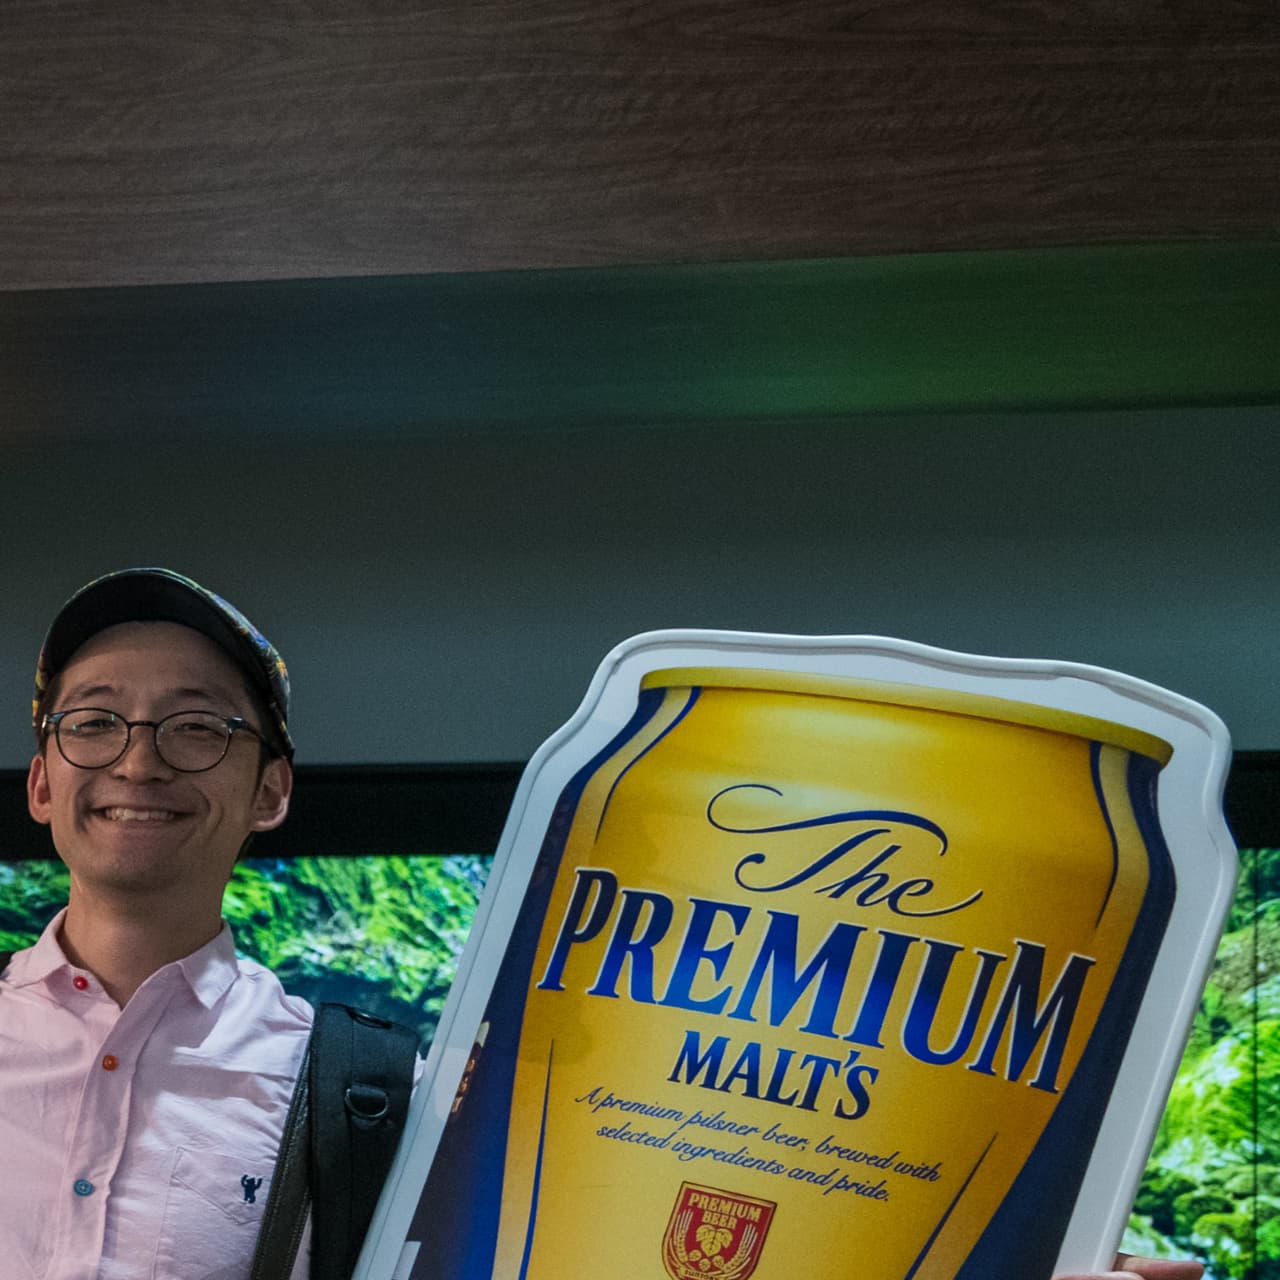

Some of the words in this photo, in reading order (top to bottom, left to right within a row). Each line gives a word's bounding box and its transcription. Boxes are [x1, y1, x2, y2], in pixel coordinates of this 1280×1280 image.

[707, 784, 983, 917] The
[536, 869, 1095, 1094] PREMIUM
[668, 1030, 880, 1121] MALT'S
[575, 1086, 598, 1103] A
[594, 1092, 685, 1128] premium
[683, 1110, 760, 1138] pilsner
[761, 1121, 811, 1153] beer,
[815, 1134, 893, 1171] brewed
[893, 1159, 941, 1183] with
[596, 1122, 671, 1151] selected
[670, 1137, 784, 1176] ingredients
[787, 1161, 835, 1187] and
[829, 1169, 891, 1203] pride.
[687, 1193, 763, 1223] PREMIUM
[701, 1210, 738, 1230] BEER
